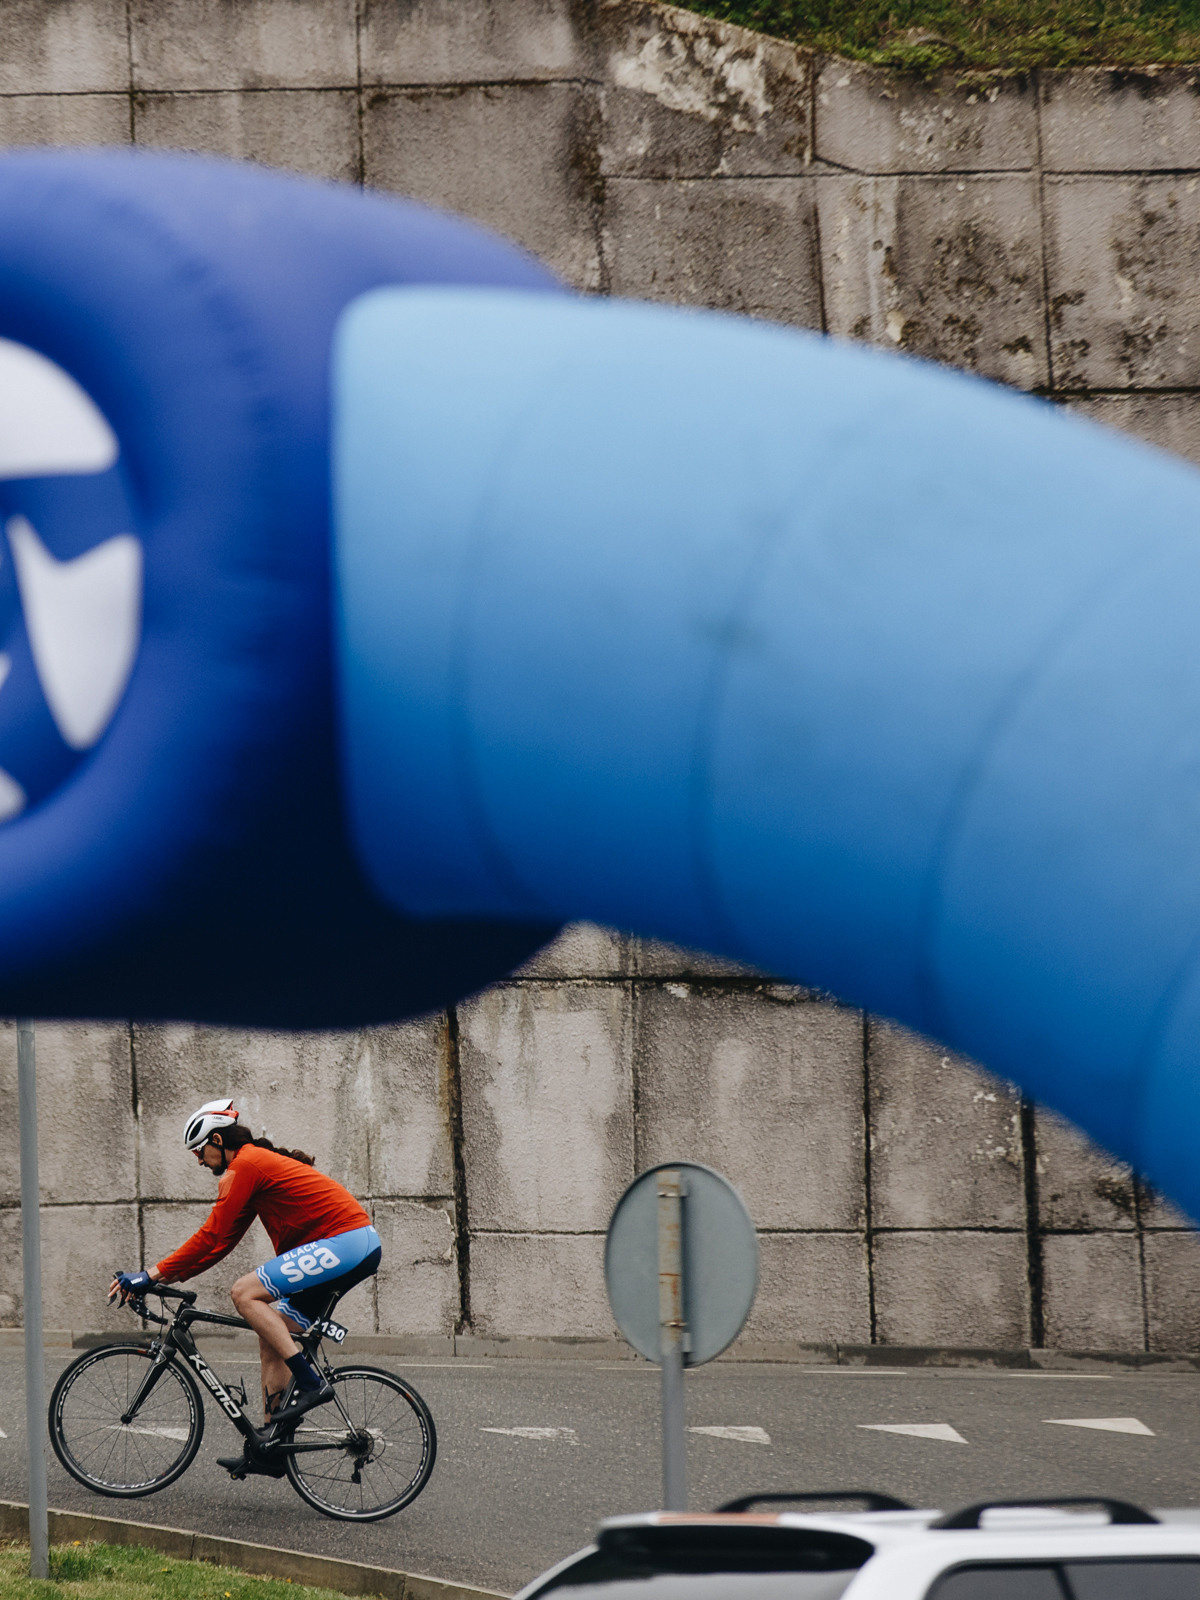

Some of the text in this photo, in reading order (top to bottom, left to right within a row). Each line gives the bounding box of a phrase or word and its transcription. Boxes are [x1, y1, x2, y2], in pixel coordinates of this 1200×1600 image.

[280, 1247, 341, 1283] sea
[282, 1241, 319, 1262] BLACK
[321, 1321, 346, 1341] 130
[189, 1354, 242, 1418] KEMO
